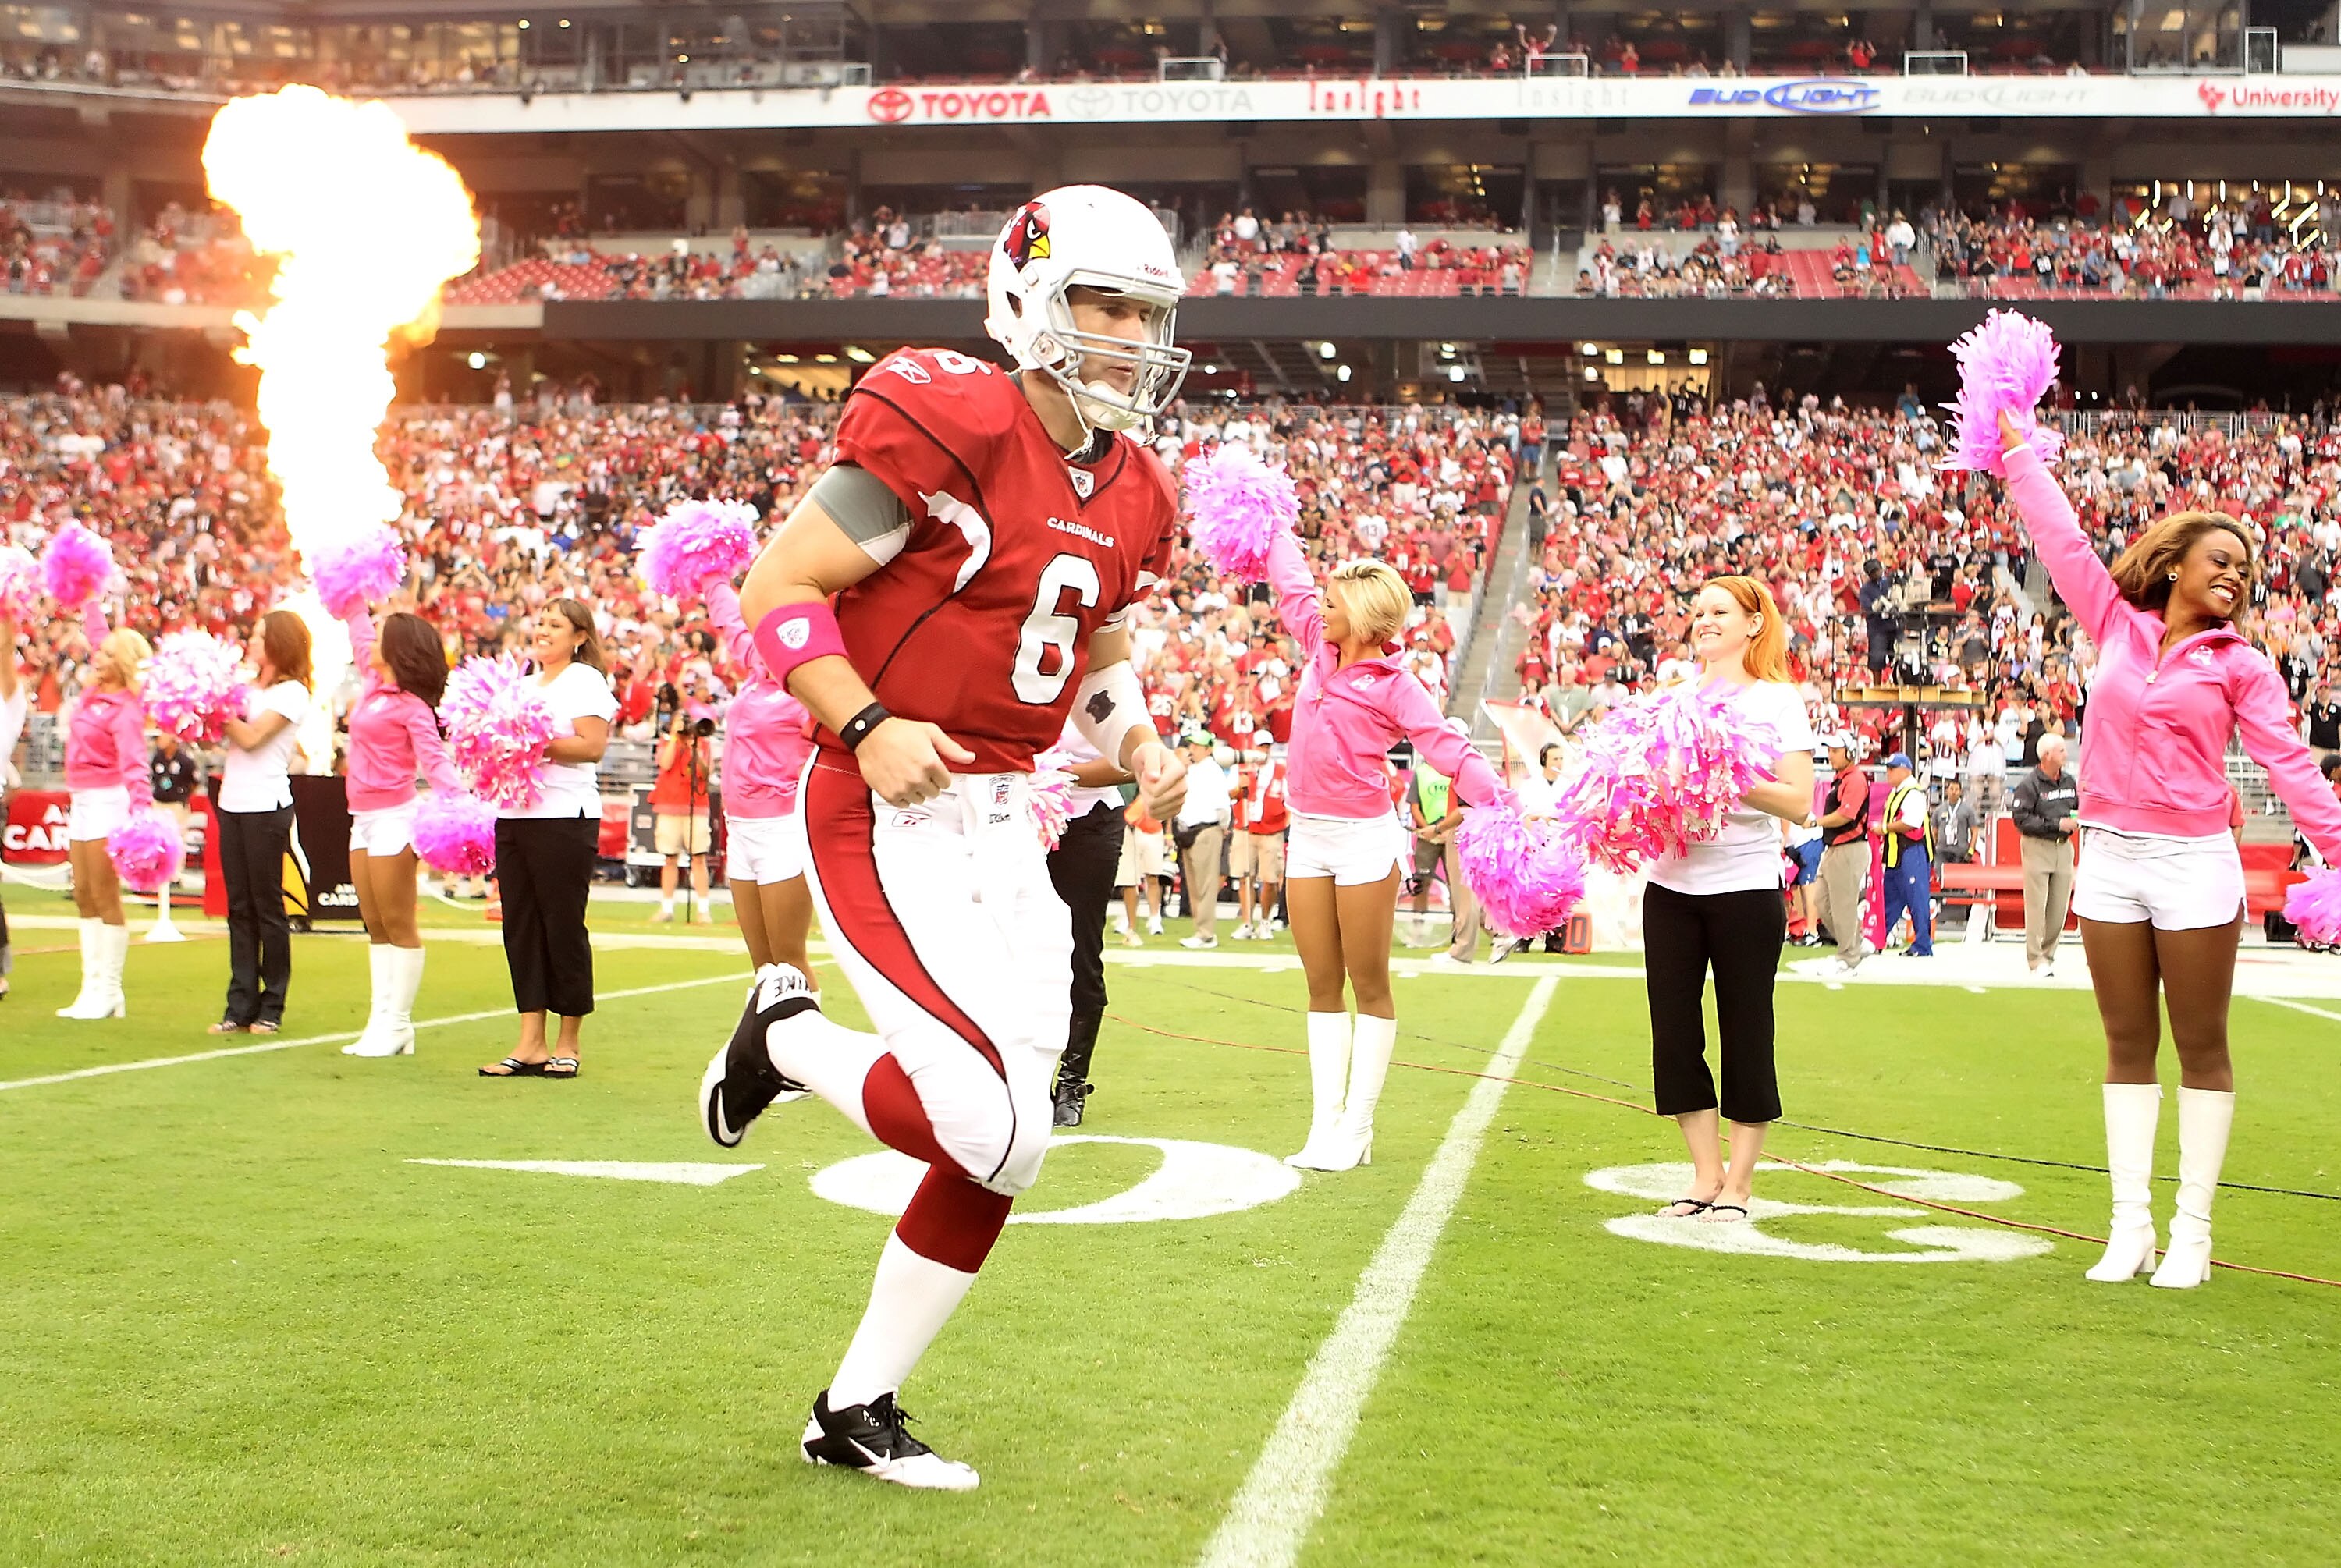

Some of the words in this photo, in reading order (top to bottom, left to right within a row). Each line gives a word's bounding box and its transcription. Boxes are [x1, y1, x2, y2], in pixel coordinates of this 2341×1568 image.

[921, 91, 1052, 118] TOYOTA
[1122, 89, 1254, 114] TOYOTA
[2233, 87, 2340, 115] University
[1046, 516, 1115, 548] CARDINALS
[1011, 552, 1101, 704] 6
